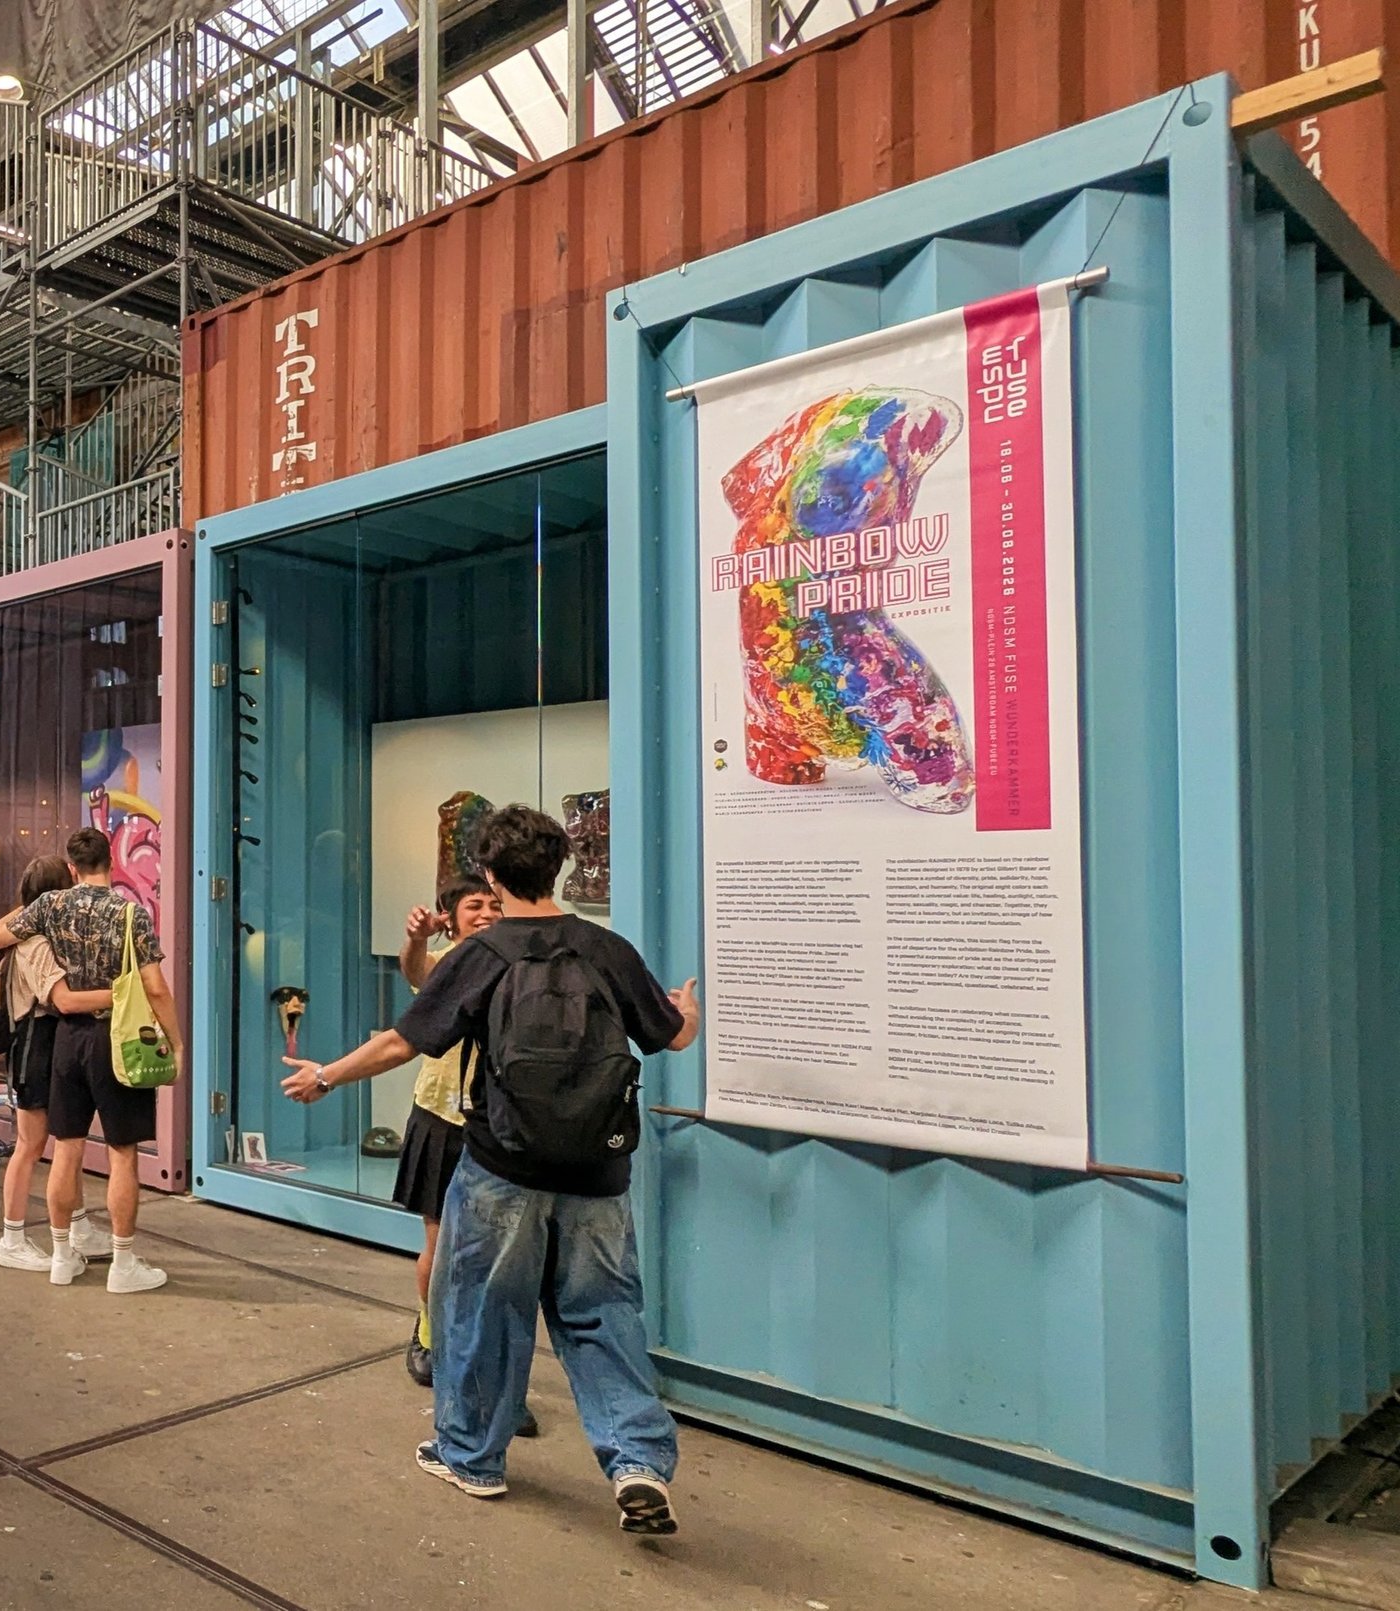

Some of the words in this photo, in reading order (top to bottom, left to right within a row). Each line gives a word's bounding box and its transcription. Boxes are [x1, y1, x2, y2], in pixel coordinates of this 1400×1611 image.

[1298, 0, 1320, 72] KU
[272, 308, 319, 497] TRIT
[711, 512, 950, 593] RAINBOW
[797, 557, 951, 619] PRIDE
[890, 604, 952, 619] EXPOSITIE
[1003, 606, 1016, 648] NDSM
[989, 669, 997, 717] AMSTERDAM
[1004, 652, 1017, 693] FUSE
[1006, 699, 1020, 817] WUNDERKAMMER
